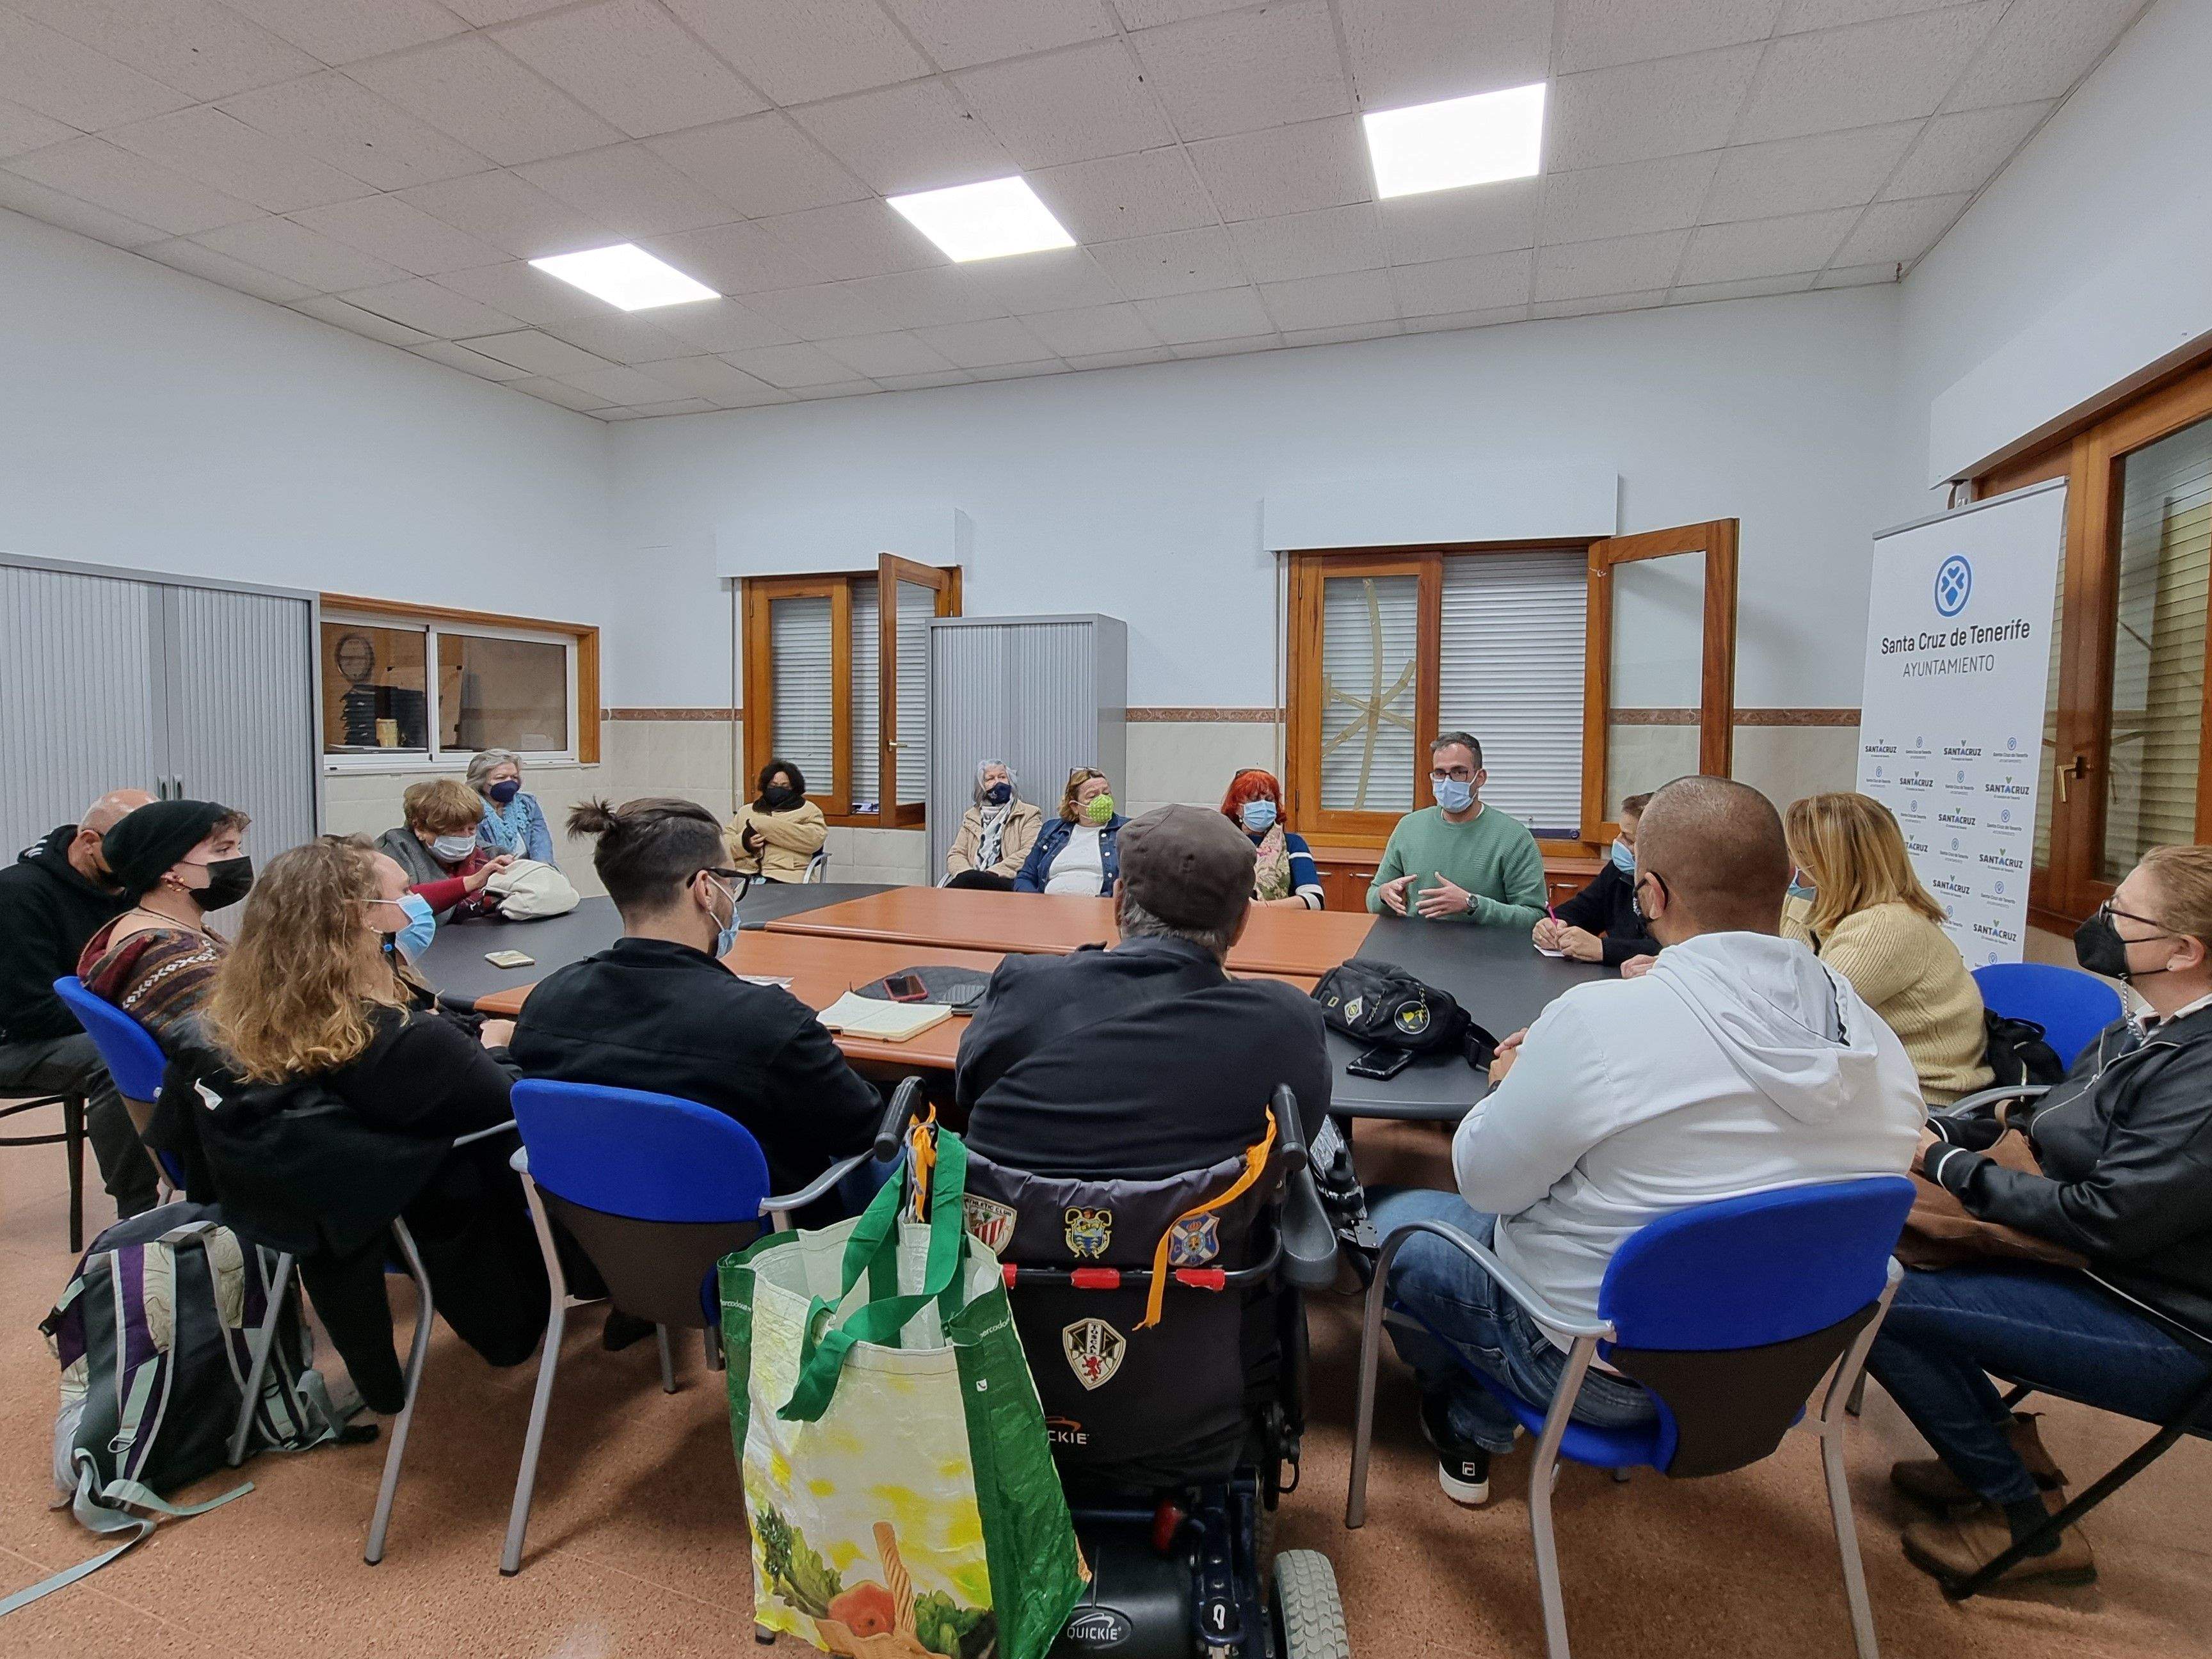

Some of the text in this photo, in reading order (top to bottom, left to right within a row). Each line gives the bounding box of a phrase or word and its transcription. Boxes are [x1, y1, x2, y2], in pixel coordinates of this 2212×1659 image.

[1881, 619, 2030, 654] Santa Cruz de Tenerife
[1902, 654, 1994, 678] AYUNTAMIENTO
[1944, 748, 1982, 756] SANTACRUZ
[1899, 778, 1934, 787] SANTACRUZ
[1985, 783, 2030, 795] SANTACRUZ
[1938, 813, 1976, 825] SANTACRUZ
[1905, 842, 1928, 852] TACRUZ
[1979, 854, 2023, 869] SANTACRUZ
[1932, 879, 1970, 894] SANTACRUZ
[1973, 924, 2017, 942] SANTACRUZ
[1048, 1430, 1087, 1445] CKIE
[1067, 1626, 1118, 1640] QUICKIE
